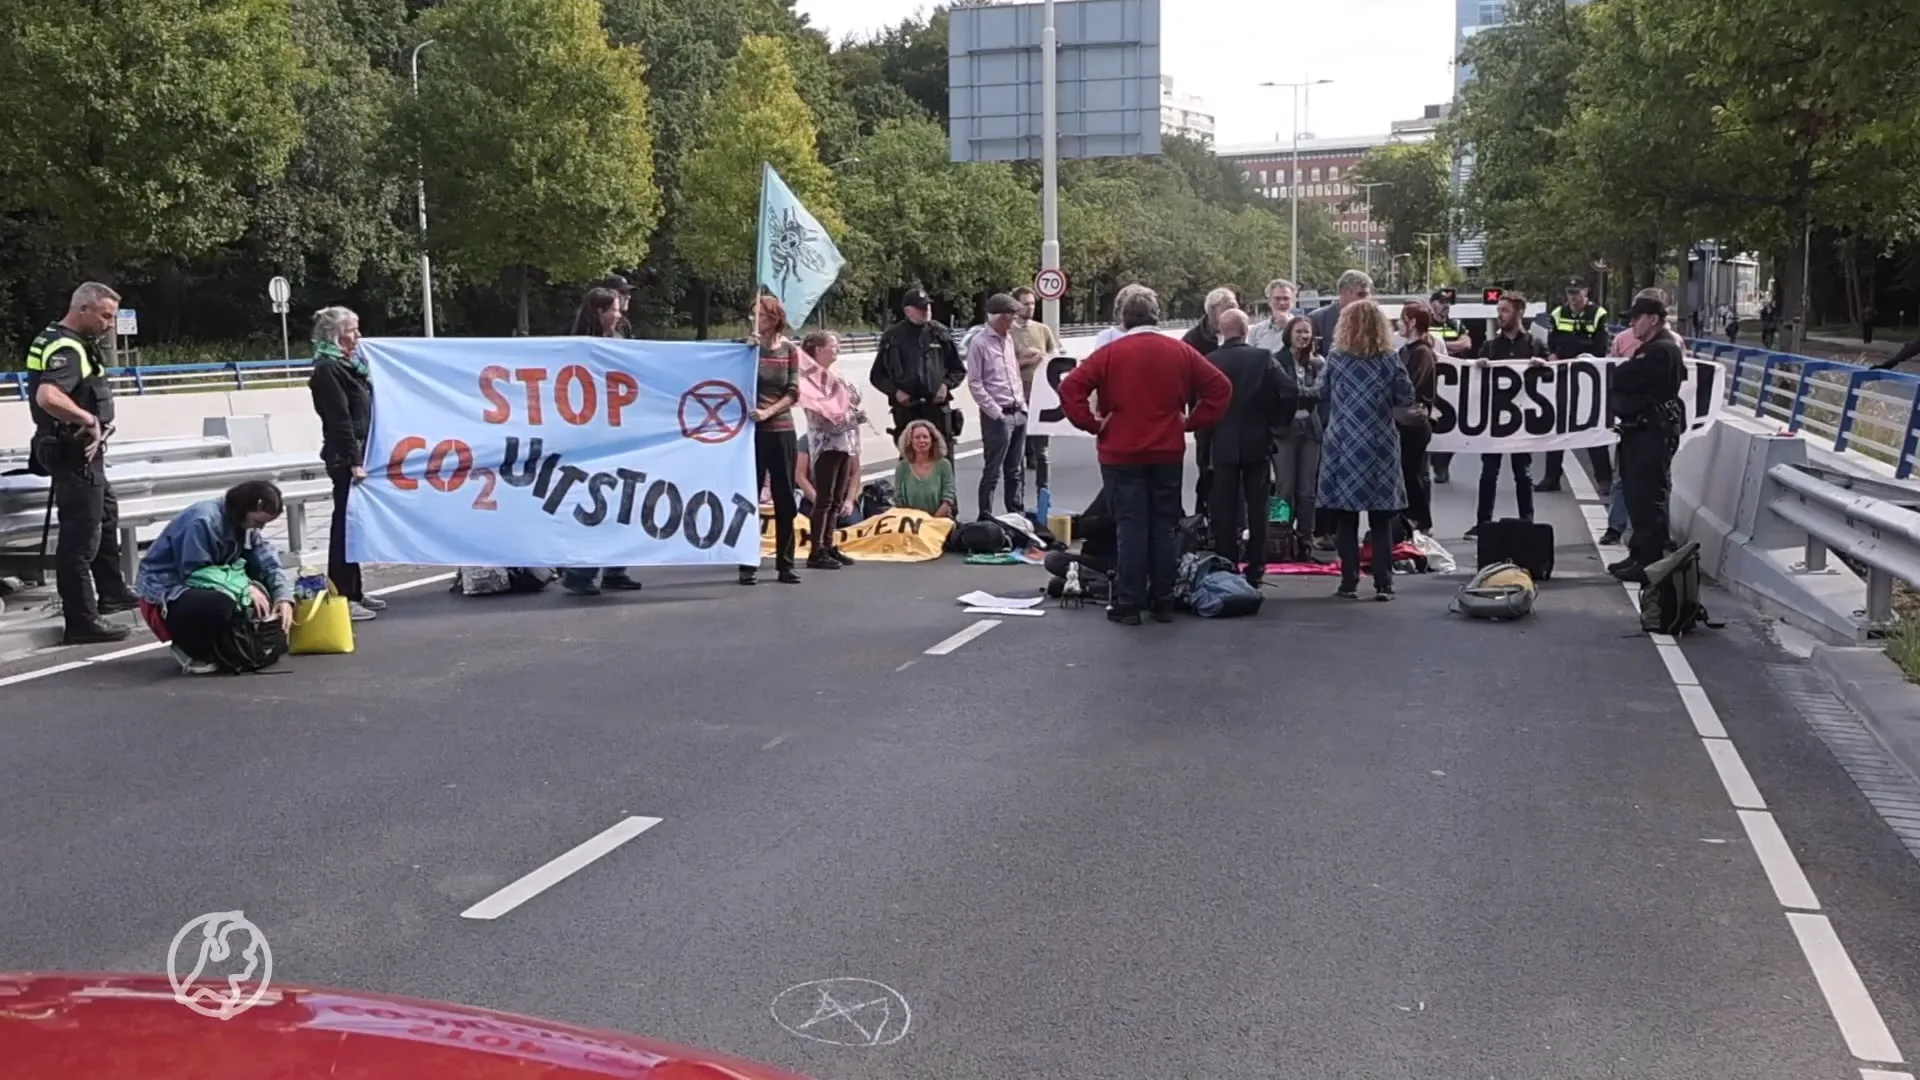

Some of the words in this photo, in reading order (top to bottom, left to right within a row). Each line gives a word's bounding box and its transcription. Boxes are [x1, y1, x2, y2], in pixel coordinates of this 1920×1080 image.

[1042, 278, 1060, 290] 70
[479, 365, 639, 427] STOP
[498, 437, 756, 550] UITSTOOT
